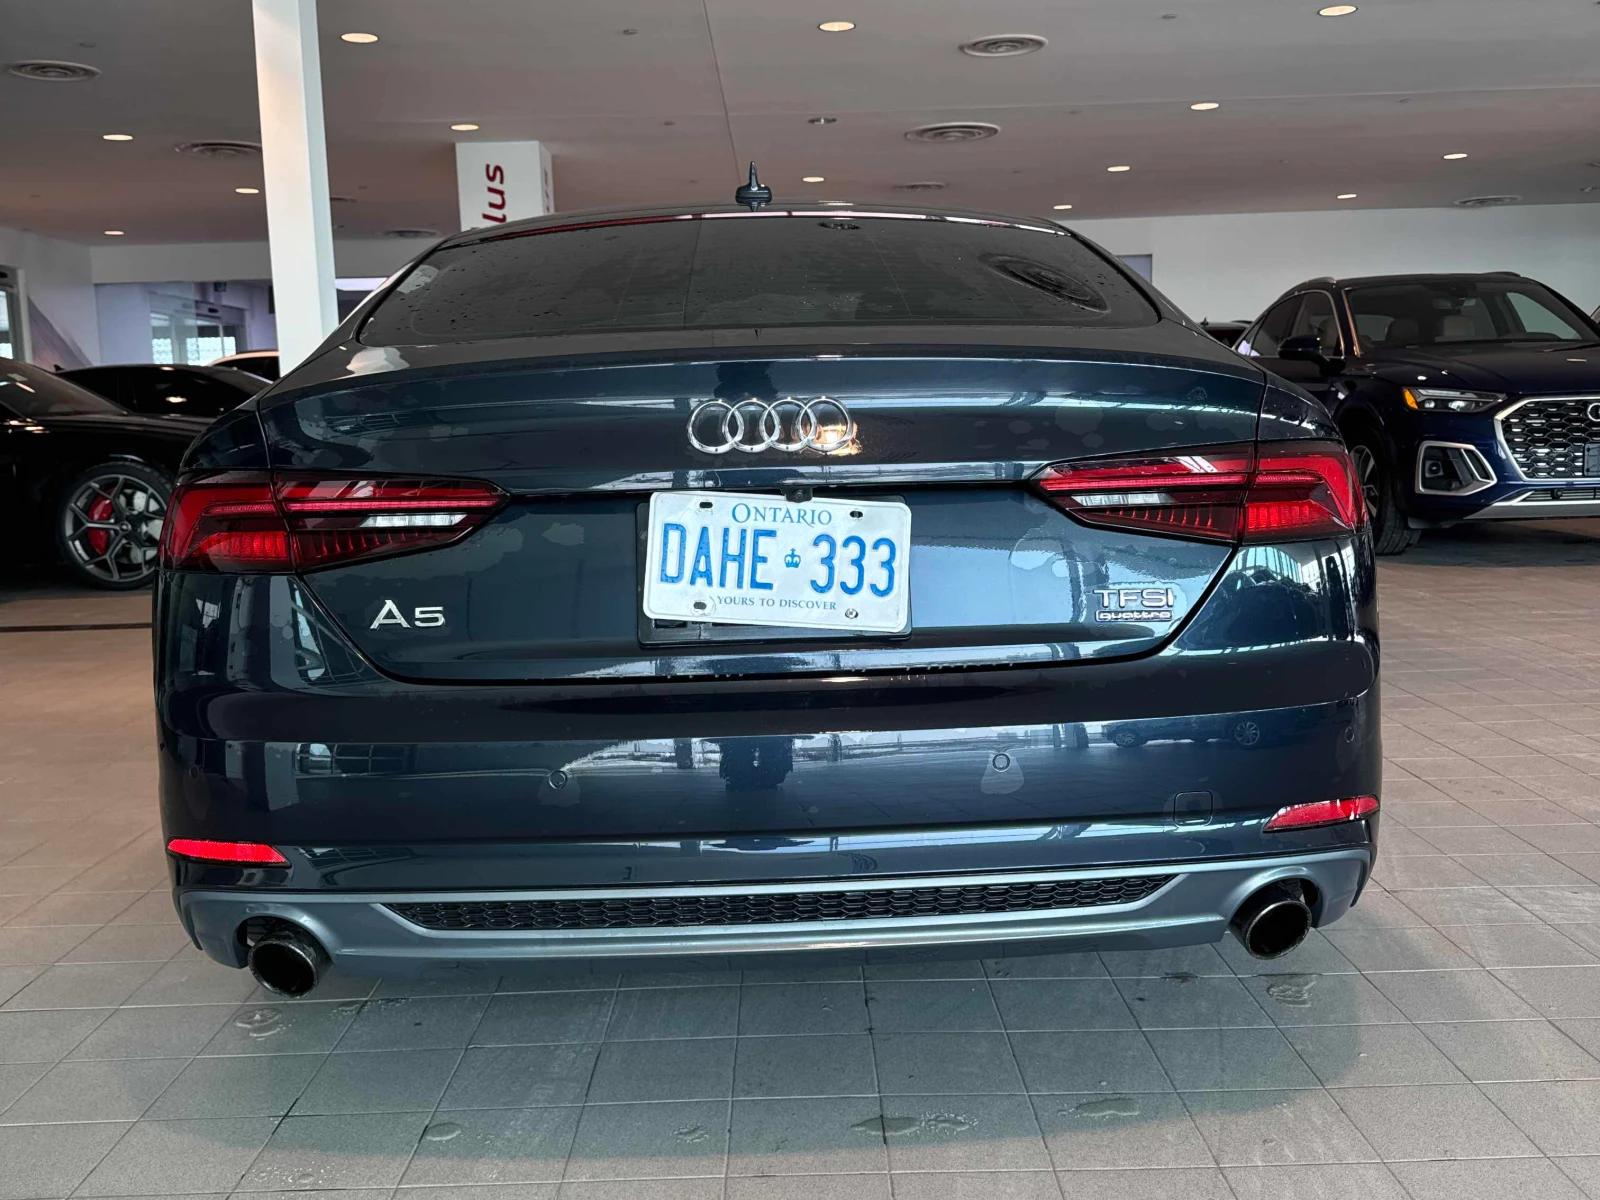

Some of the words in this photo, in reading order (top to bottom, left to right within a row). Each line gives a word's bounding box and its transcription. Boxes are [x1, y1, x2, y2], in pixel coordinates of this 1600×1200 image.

[659, 522, 777, 590] DAHE
[809, 533, 897, 597] 333
[716, 595, 755, 607] YOURS
[760, 597, 775, 607] TO
[779, 598, 837, 611] DISCOVER
[1093, 587, 1174, 608] TFSI
[369, 599, 446, 630] A5
[1098, 610, 1172, 621] quattro
